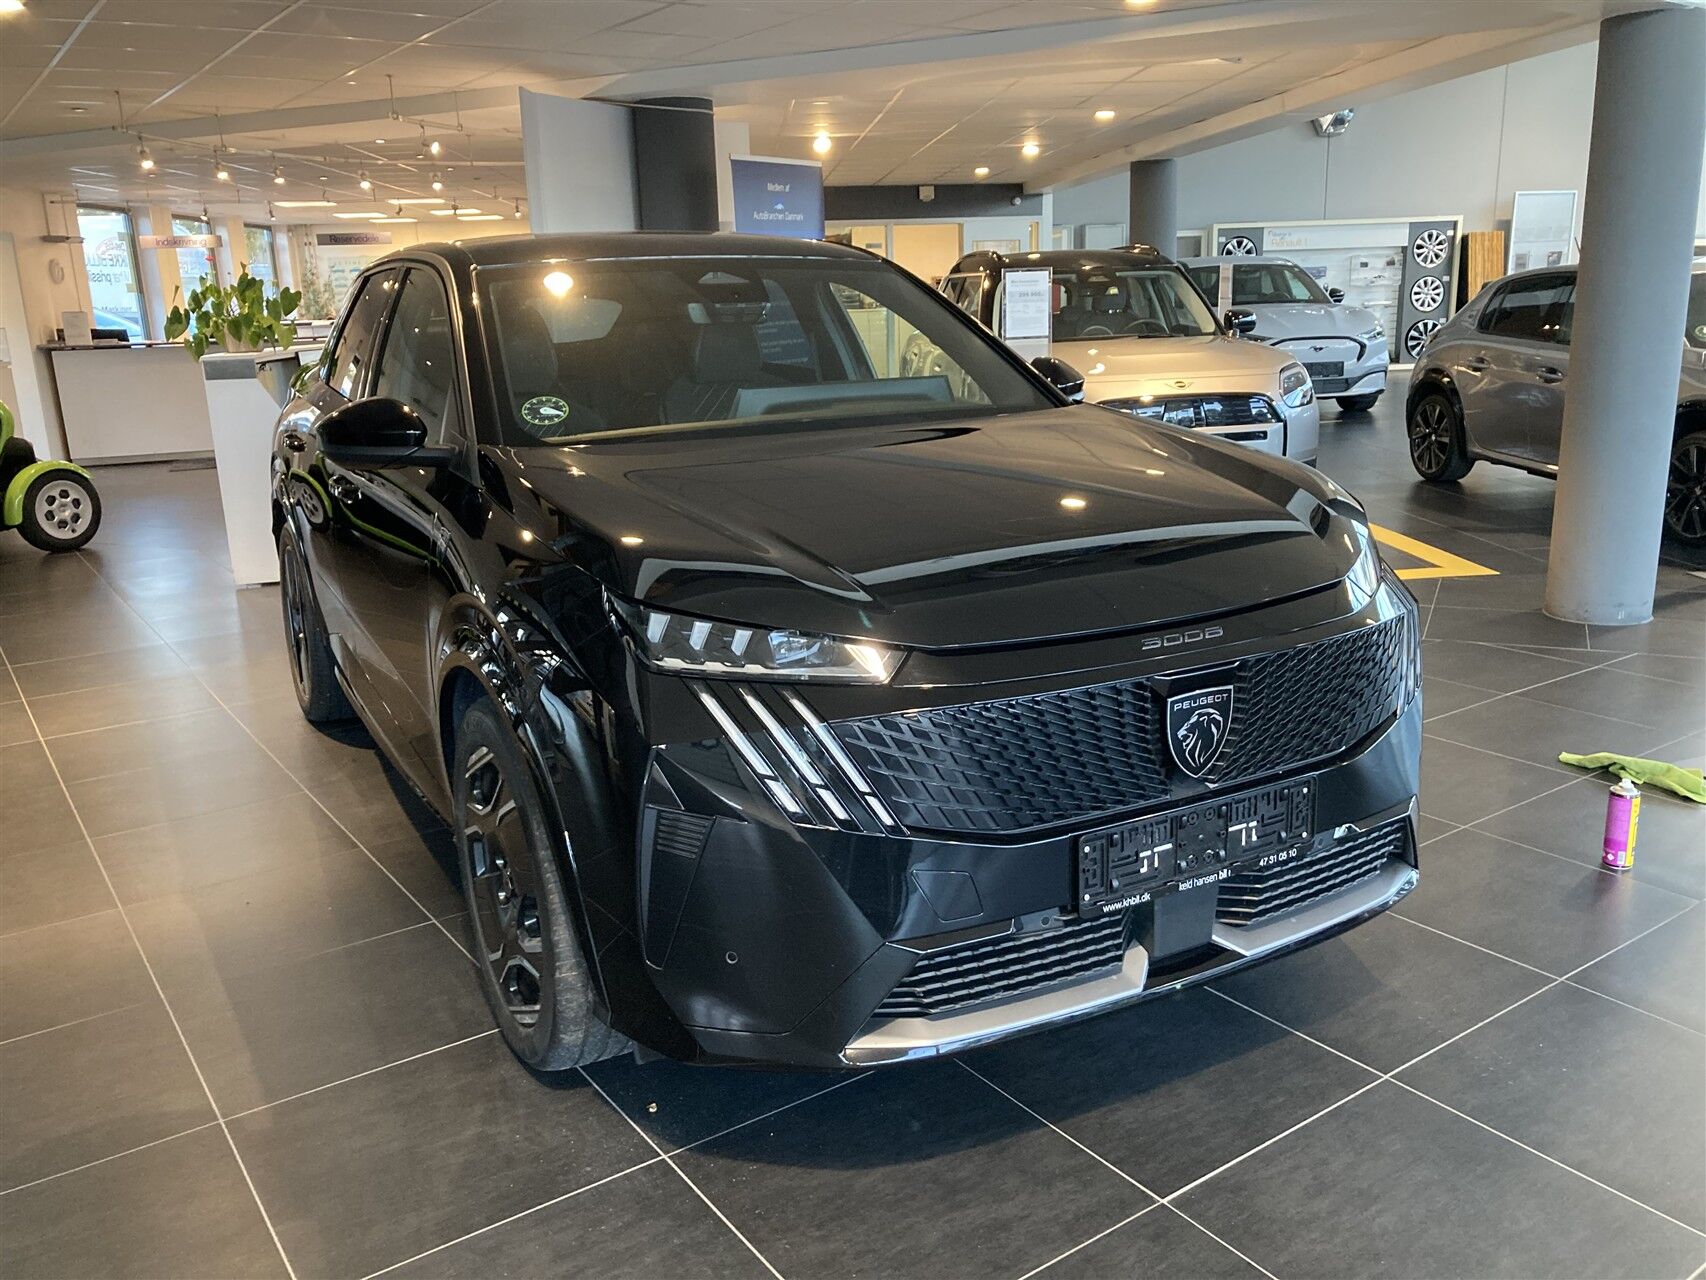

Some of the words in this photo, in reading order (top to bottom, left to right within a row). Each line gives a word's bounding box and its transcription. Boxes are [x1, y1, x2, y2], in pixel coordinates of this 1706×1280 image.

[1141, 626, 1224, 650] 3008
[1173, 693, 1229, 712] PEUGEOT
[1102, 892, 1151, 913] www.khbil.dk
[1178, 879, 1193, 892] keld
[1193, 873, 1218, 887] hansen
[1259, 856, 1268, 867] 47
[1269, 854, 1277, 865] 31
[1288, 848, 1297, 858] 10
